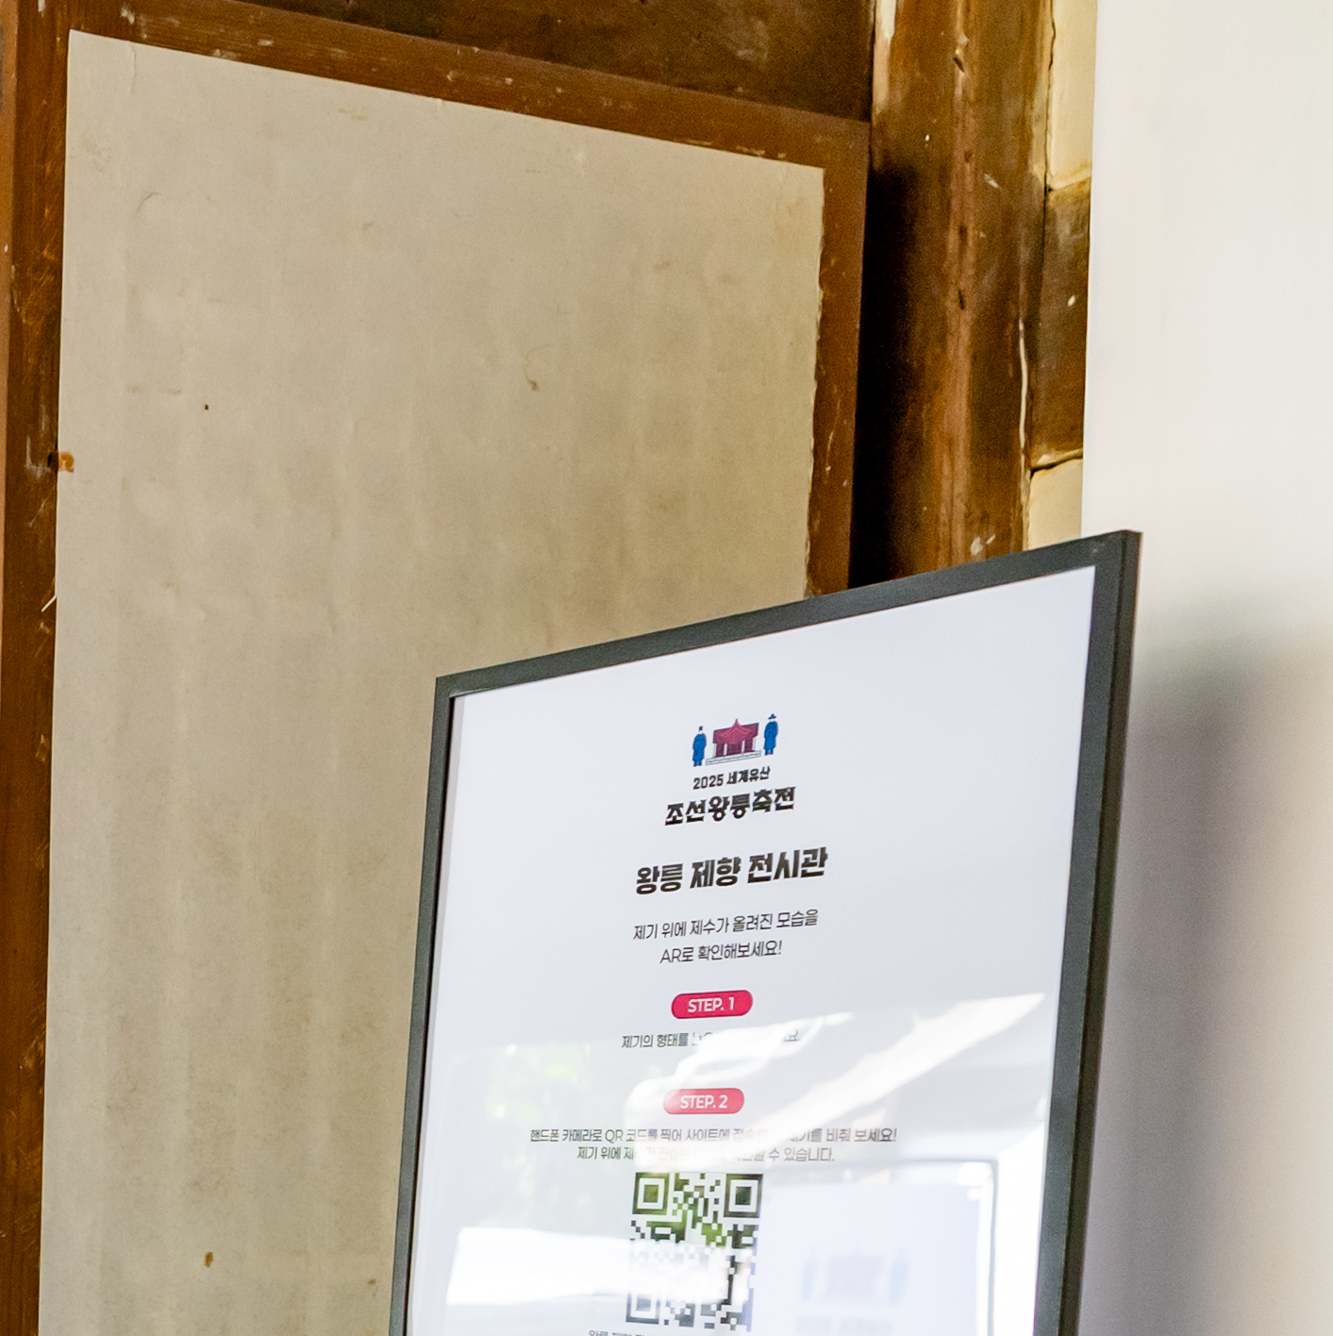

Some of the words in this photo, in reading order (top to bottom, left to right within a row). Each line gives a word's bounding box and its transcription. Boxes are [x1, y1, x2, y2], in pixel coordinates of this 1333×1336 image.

[693, 775, 724, 790] 2025
[726, 765, 771, 785] 세계유산
[664, 786, 797, 826] 조선왕릉축전
[636, 863, 683, 895] 왕릉
[689, 856, 742, 889] 제향
[747, 846, 828, 883] 전시관
[633, 924, 658, 940] 제기
[662, 921, 687, 938] 위에
[689, 917, 729, 935] 제수가
[732, 912, 773, 932] 올려진
[776, 908, 818, 928] 모습을
[659, 946, 694, 964] AR로
[698, 939, 783, 961] 확인해보세요!
[687, 997, 726, 1013] STEP.
[727, 996, 735, 1011] 1
[621, 1034, 653, 1048] 제기의
[657, 1032, 689, 1047] 형태를
[680, 1095, 717, 1109] STEP.
[717, 1094, 728, 1109] 2
[562, 1128, 602, 1142] 카메라로
[604, 1129, 624, 1144] QR
[626, 1128, 657, 1142] 코드를
[660, 1128, 682, 1142] 찍어
[685, 1128, 730, 1142] 사이트에
[826, 1128, 850, 1142] 비춰
[854, 1128, 897, 1142] 보세요!
[577, 1146, 598, 1160] 제기
[600, 1146, 621, 1160] 위에
[768, 1147, 780, 1162] 수
[784, 1147, 835, 1162] 있습니다.
